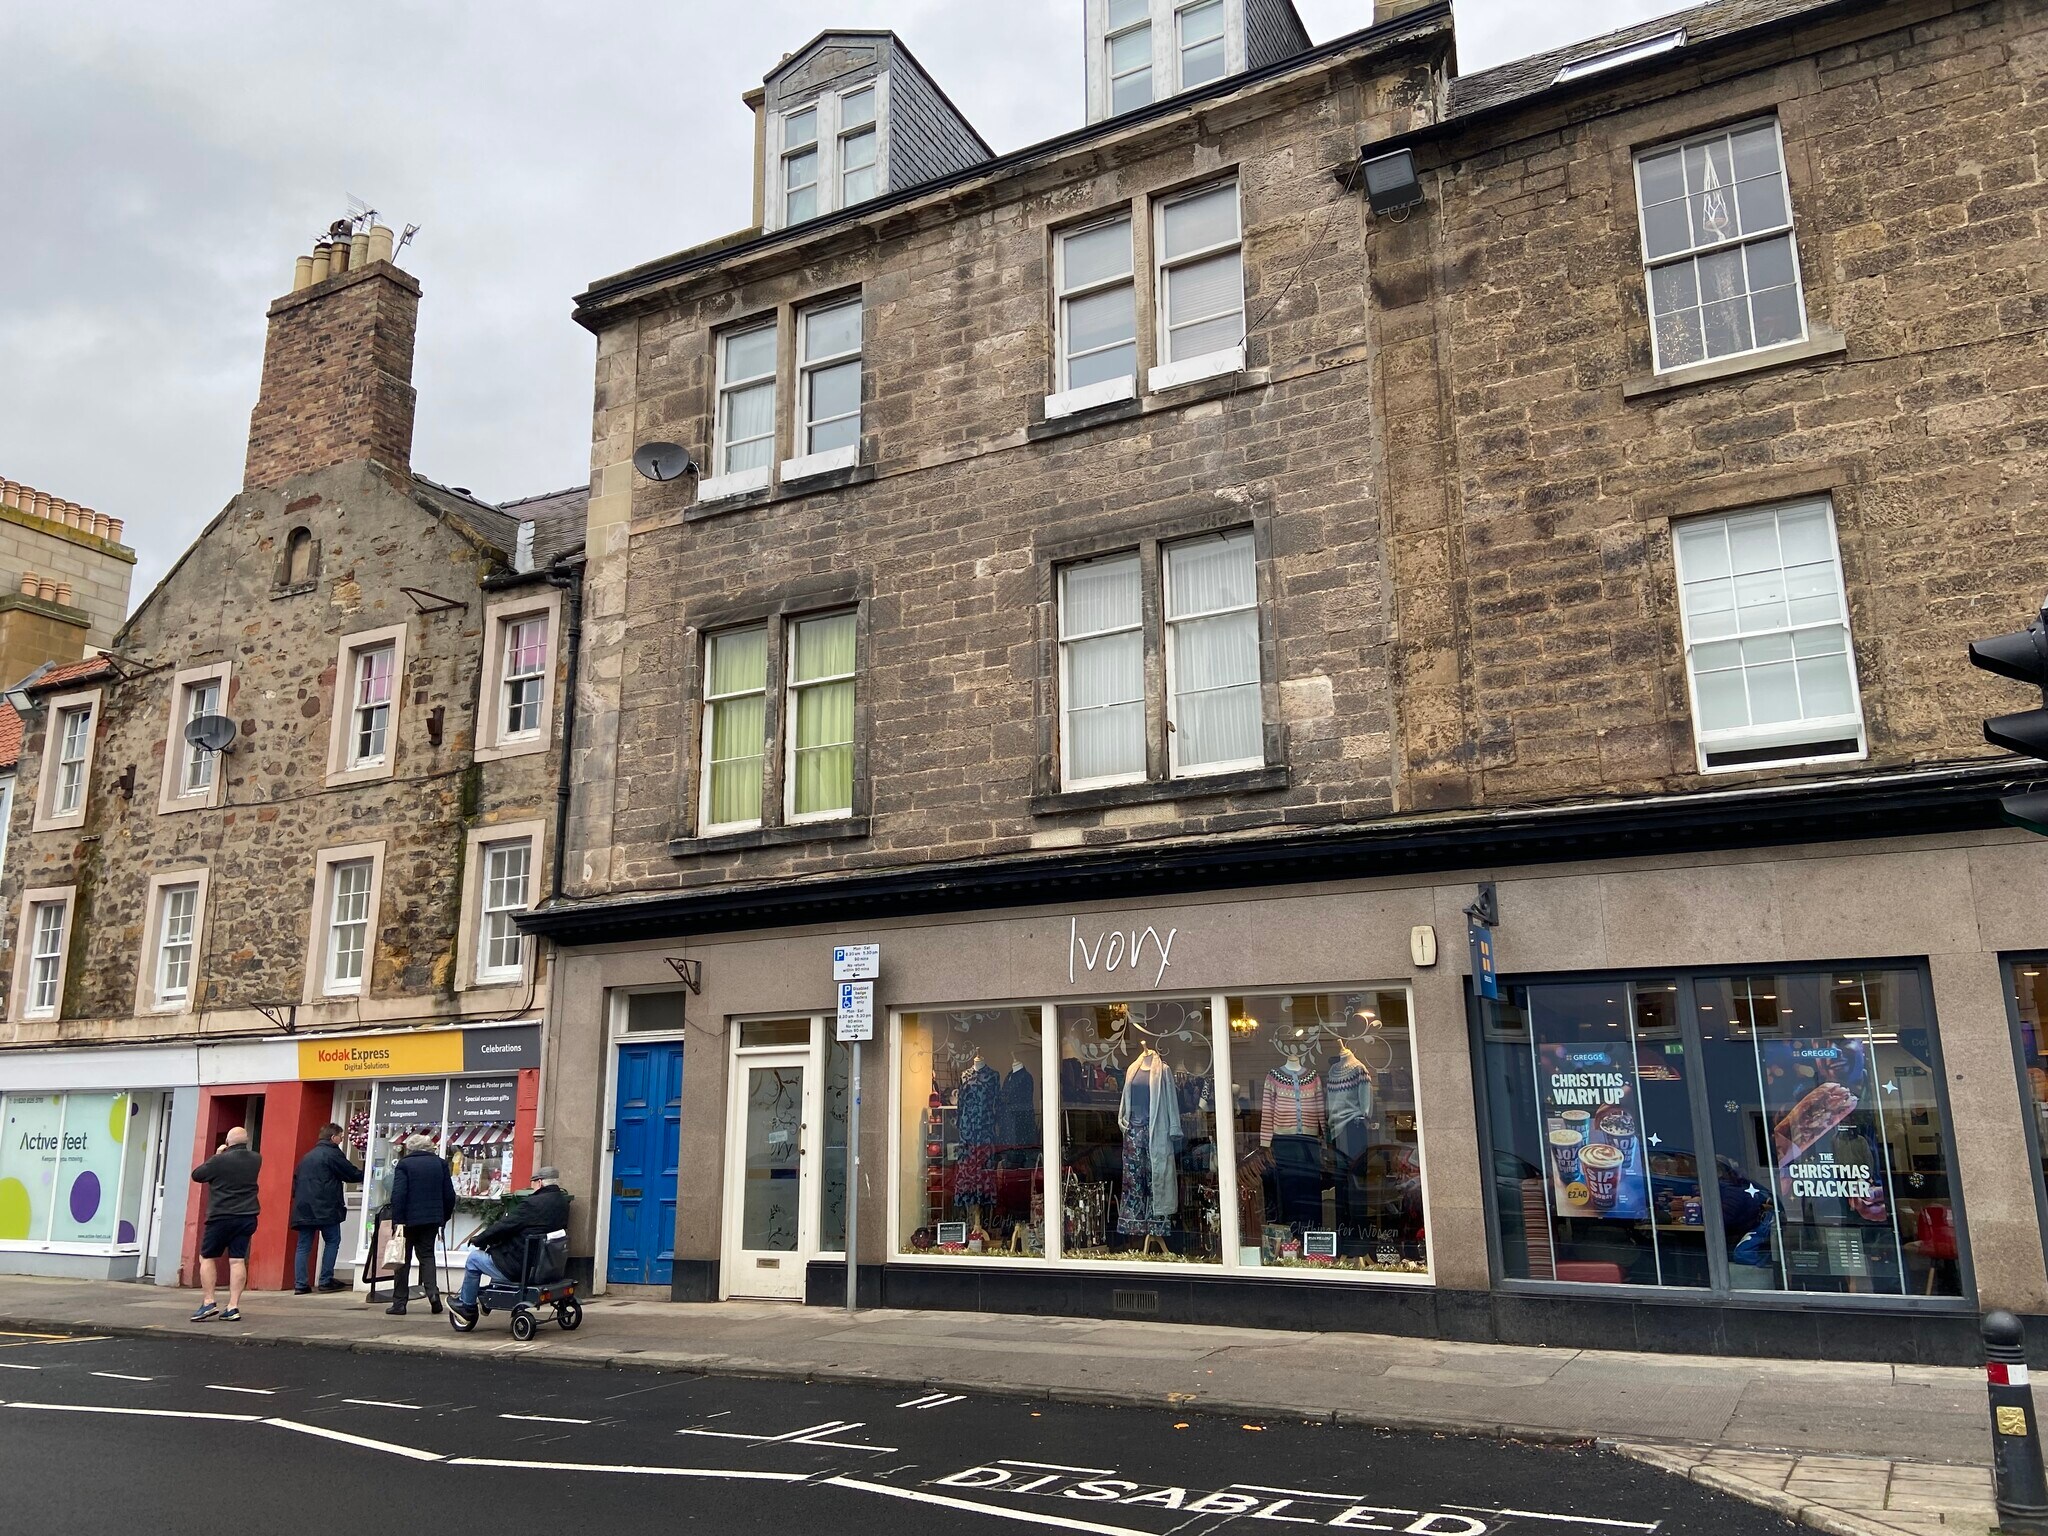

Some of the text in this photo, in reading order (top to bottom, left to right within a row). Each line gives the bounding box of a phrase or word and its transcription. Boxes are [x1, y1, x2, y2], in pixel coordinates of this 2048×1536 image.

[1069, 917, 1177, 988] Ivory
[318, 1048, 390, 1062] Kodak Express
[481, 1044, 522, 1054] Celebrations
[344, 1062, 390, 1072] Digital Solutions
[1551, 1072, 1624, 1088] CHRISTMAS
[1552, 1088, 1625, 1105] WARM UP
[20, 1132, 88, 1150] Active feet
[1819, 1153, 1834, 1161] THE
[1586, 1168, 1614, 1182] SIP
[1789, 1164, 1870, 1179] CHRISTMAS
[1568, 1190, 1588, 1199] £2.40
[1590, 1180, 1614, 1194] SIP
[1792, 1180, 1871, 1198] CRACKER
[1336, 1222, 1354, 1236] for
[1358, 1224, 1399, 1240] Women
[935, 1467, 1488, 1536] DISABLED
